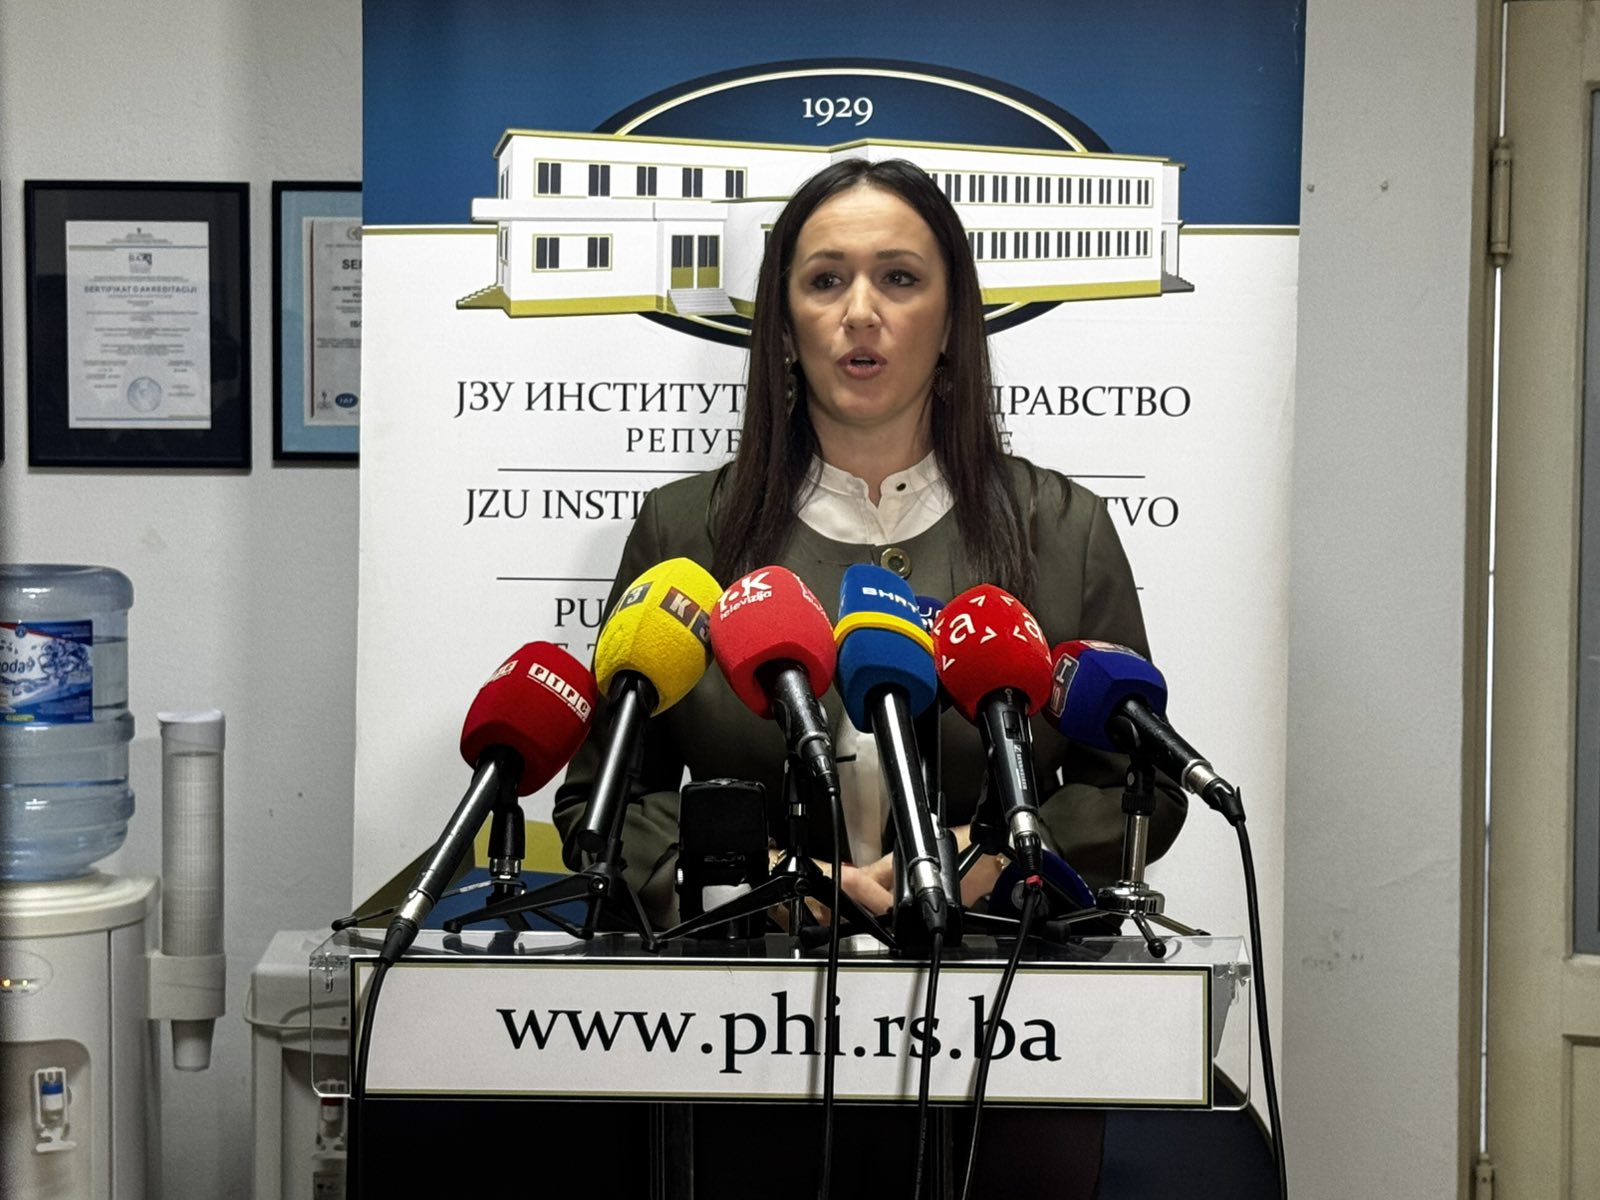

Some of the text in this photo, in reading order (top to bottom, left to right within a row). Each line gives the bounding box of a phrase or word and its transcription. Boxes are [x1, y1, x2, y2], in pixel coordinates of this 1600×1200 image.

[802, 97, 874, 127] 1929
[453, 380, 516, 419] ЈЗУ
[524, 381, 748, 415] ИНСТИТУТ
[462, 484, 531, 527] JZU
[540, 487, 650, 521] INSTI
